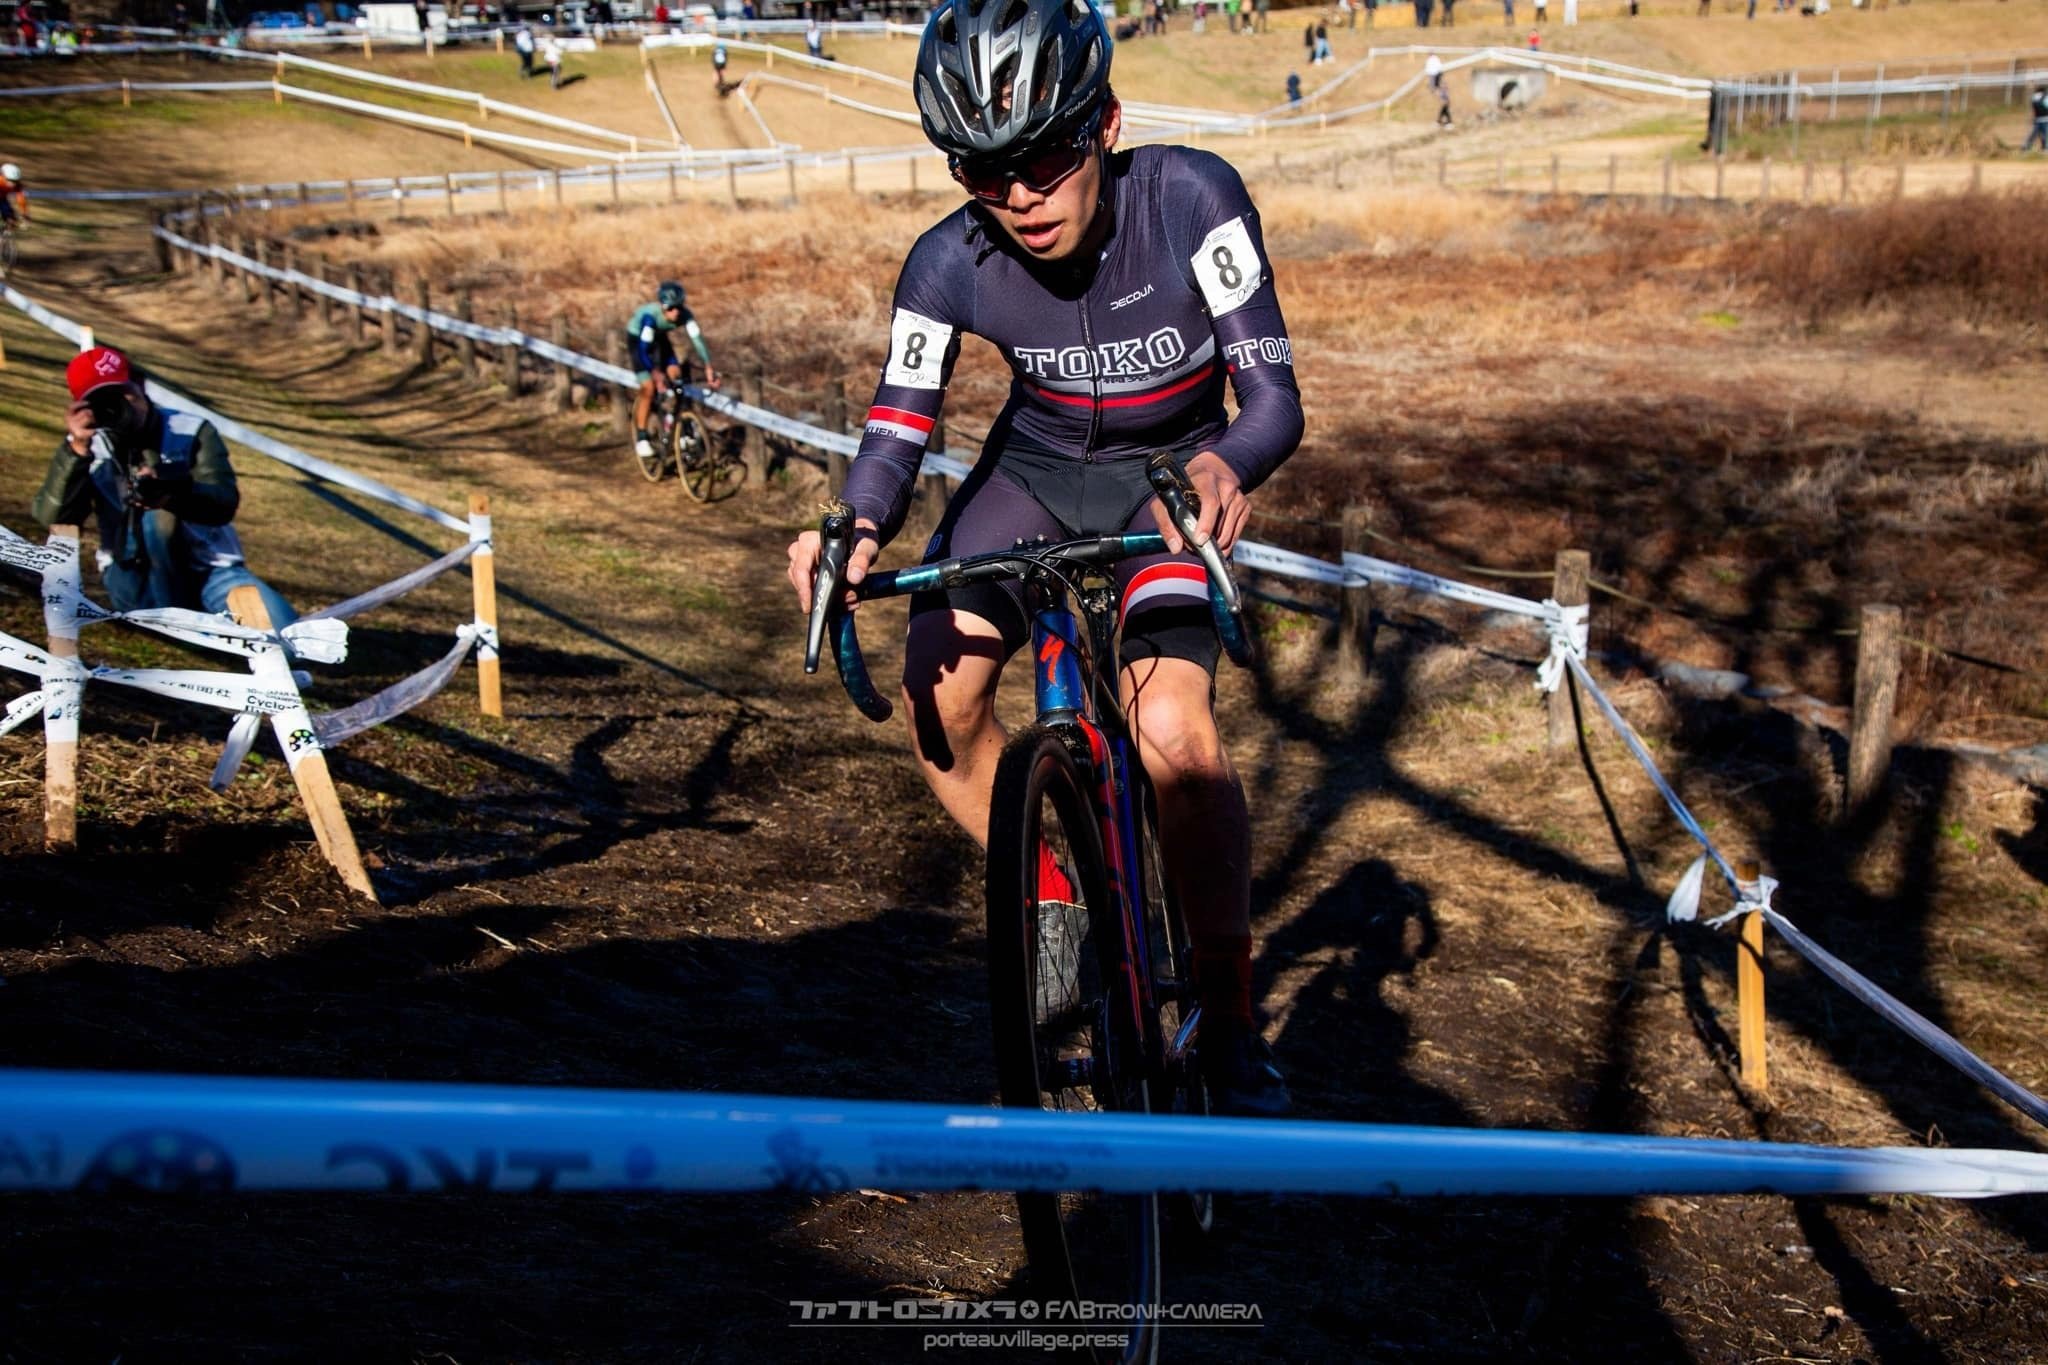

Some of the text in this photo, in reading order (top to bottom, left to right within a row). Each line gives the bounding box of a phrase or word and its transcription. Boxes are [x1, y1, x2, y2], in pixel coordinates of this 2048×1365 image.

[1212, 245, 1242, 290] 8
[902, 331, 927, 370] 8
[1013, 326, 1186, 379] TOKO
